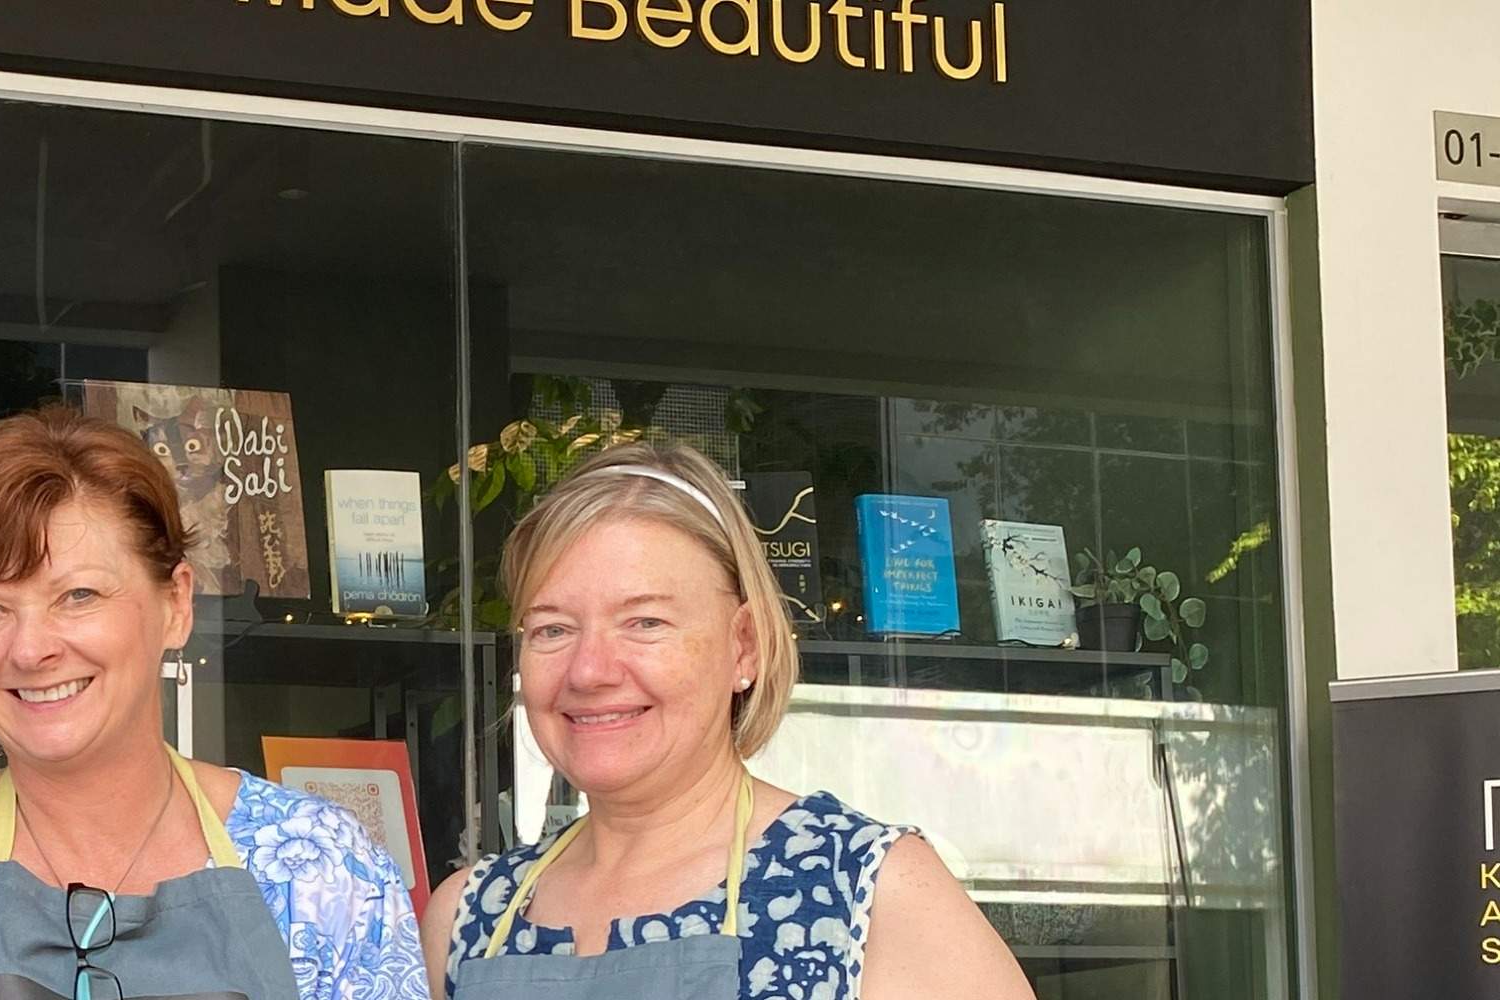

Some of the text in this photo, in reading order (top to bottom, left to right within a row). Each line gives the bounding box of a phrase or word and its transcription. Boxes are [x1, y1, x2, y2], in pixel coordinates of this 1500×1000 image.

[572, 0, 1007, 82] Beautiful
[215, 407, 288, 456] Wabi
[224, 456, 292, 504] Sabi
[1011, 595, 1062, 610] IKIGAI
